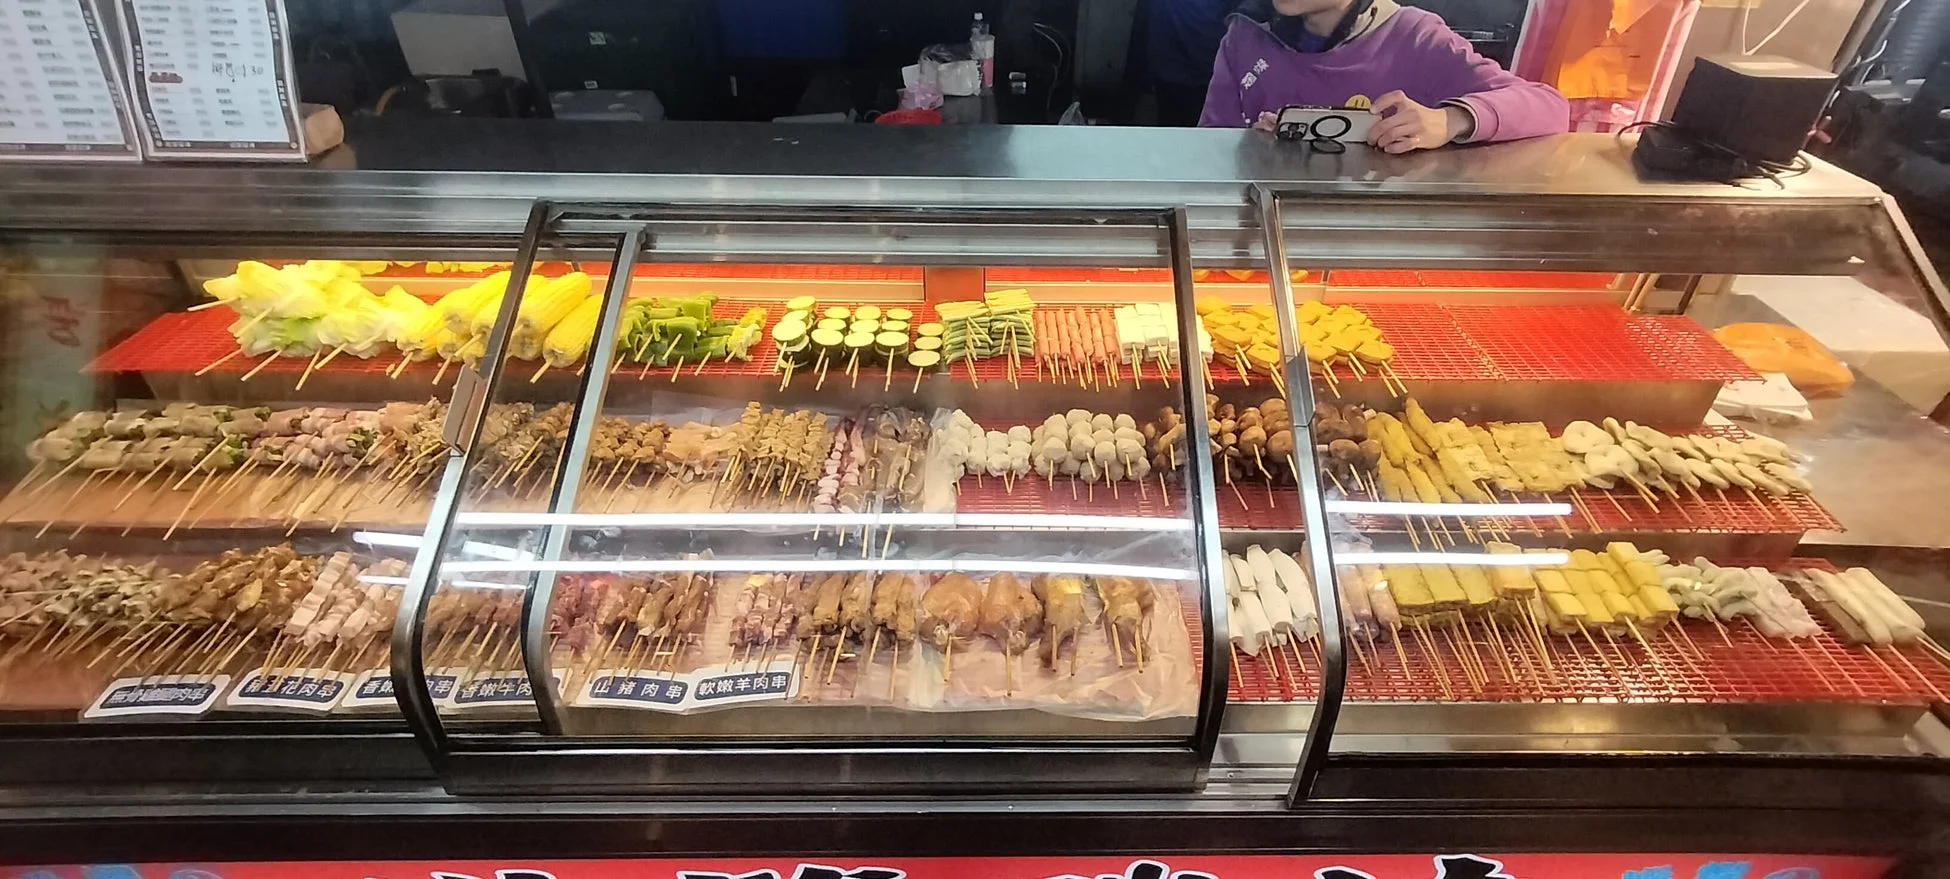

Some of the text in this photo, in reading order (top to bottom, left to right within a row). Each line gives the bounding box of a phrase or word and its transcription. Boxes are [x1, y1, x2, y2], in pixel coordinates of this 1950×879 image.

[461, 681, 533, 699] 香嫩牛肉
[593, 679, 684, 700] 山豬肉串
[698, 674, 788, 697] 軟嫩羊肉串
